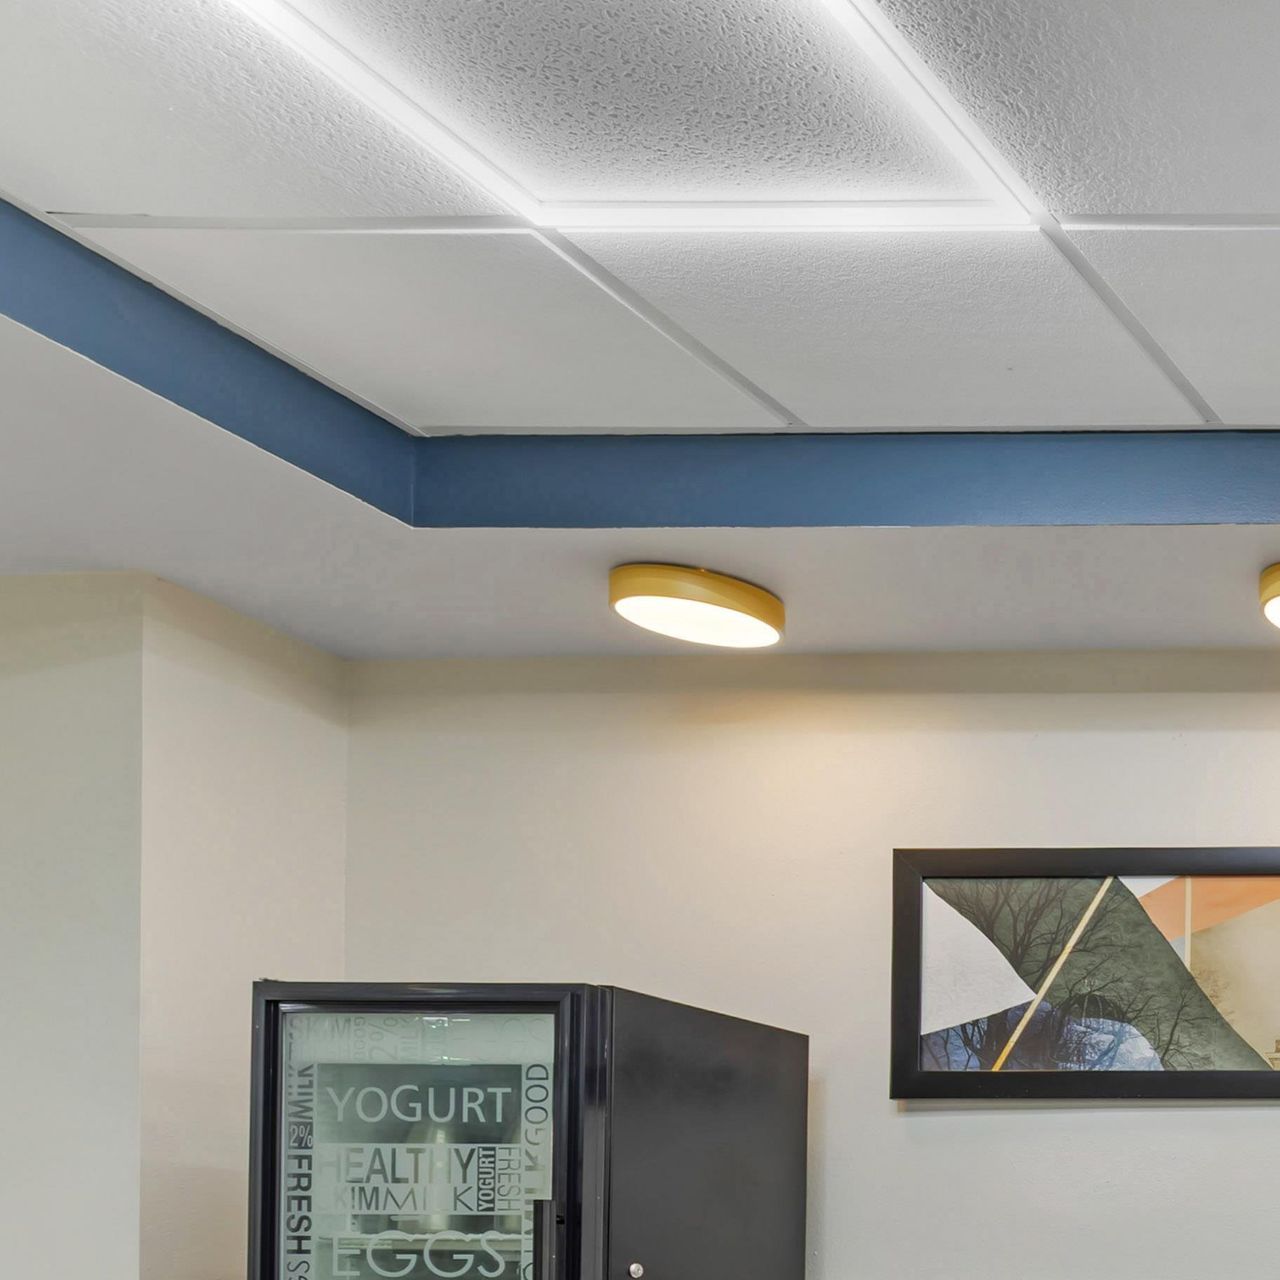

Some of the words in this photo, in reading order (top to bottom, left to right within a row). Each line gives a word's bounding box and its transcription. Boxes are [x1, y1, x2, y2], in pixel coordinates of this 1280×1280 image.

[327, 1084, 512, 1123] YOGURT
[524, 1063, 549, 1146] GOOD
[289, 1125, 314, 1148] 2%
[319, 1147, 477, 1184] HEALTHY
[478, 1147, 495, 1212] YOGURT
[497, 1146, 522, 1212] FRESH
[286, 1154, 313, 1255] FRESH
[332, 1230, 506, 1278] EGGS
